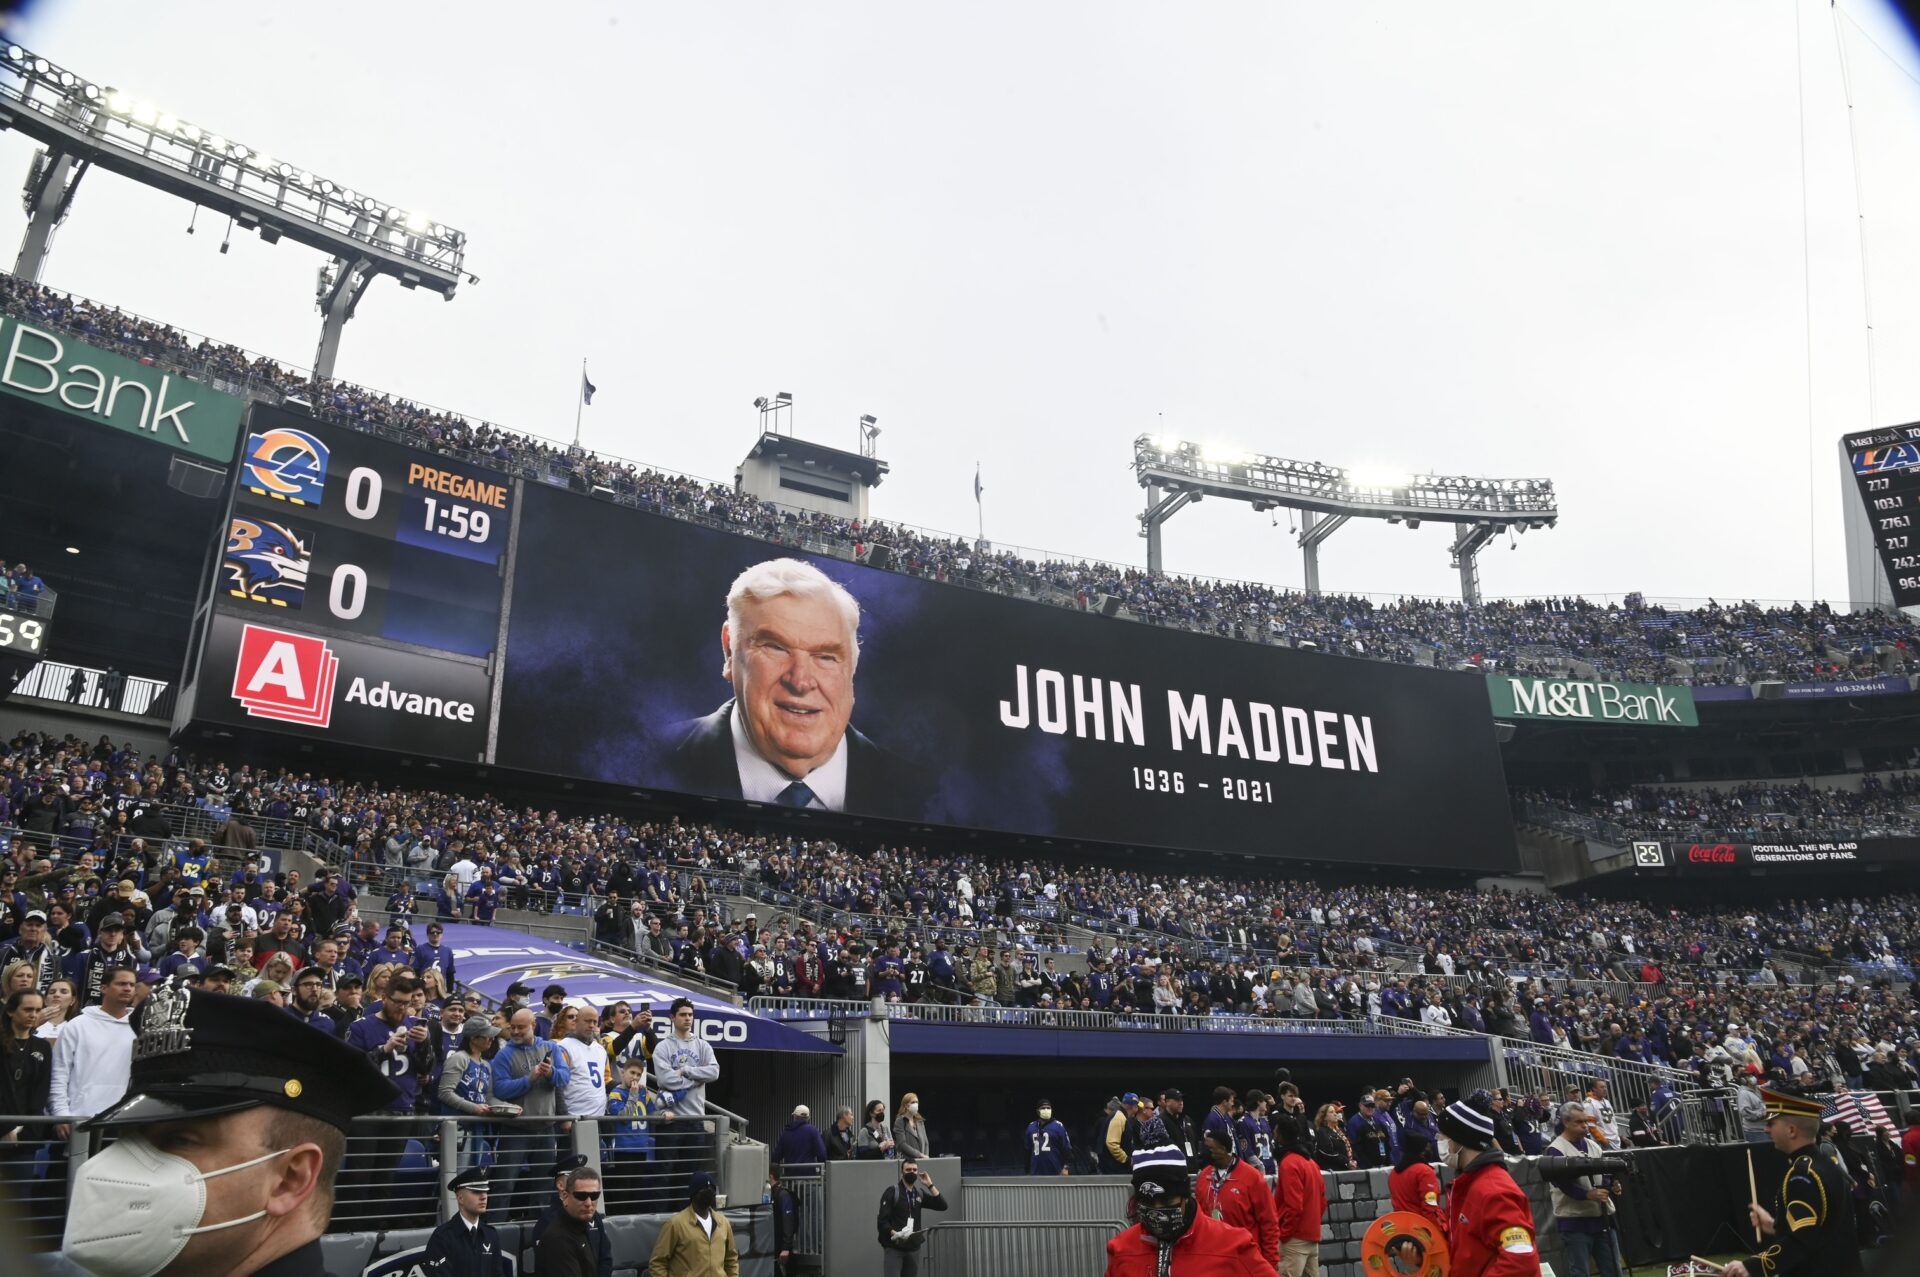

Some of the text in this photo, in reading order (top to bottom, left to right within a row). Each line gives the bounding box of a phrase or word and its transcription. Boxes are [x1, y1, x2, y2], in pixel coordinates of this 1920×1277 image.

[2, 324, 195, 443] Bank
[1850, 437, 1873, 447] M&T
[345, 467, 382, 520] 0
[408, 463, 508, 509] PREGAME
[1867, 478, 1889, 491] 27.7
[1874, 496, 1903, 510] 103.1
[424, 497, 490, 543] 1:59
[1880, 516, 1911, 529] 276.1
[1886, 536, 1908, 549] 21.7
[329, 563, 367, 620] 0
[246, 640, 305, 700] A
[344, 677, 475, 722] Advance
[1508, 678, 1681, 722] M&T Bank
[999, 664, 1378, 773] JOHN MADDEN
[1132, 766, 1184, 794] 1936
[1222, 777, 1273, 803] 2021
[294, 807, 307, 818] 20
[1638, 846, 1659, 863] 25
[1753, 845, 1798, 853] FOOTBALL,
[1838, 842, 1857, 850] AND
[1755, 853, 1814, 862] GENERATIONS
[1830, 851, 1857, 860] FANS.
[182, 862, 201, 879] 52
[91, 961, 104, 998] RAVENS
[777, 963, 784, 976] 8
[910, 970, 924, 984] 27
[651, 1016, 748, 1043] GICO
[587, 1062, 602, 1089] 5
[1032, 1132, 1051, 1156] 52
